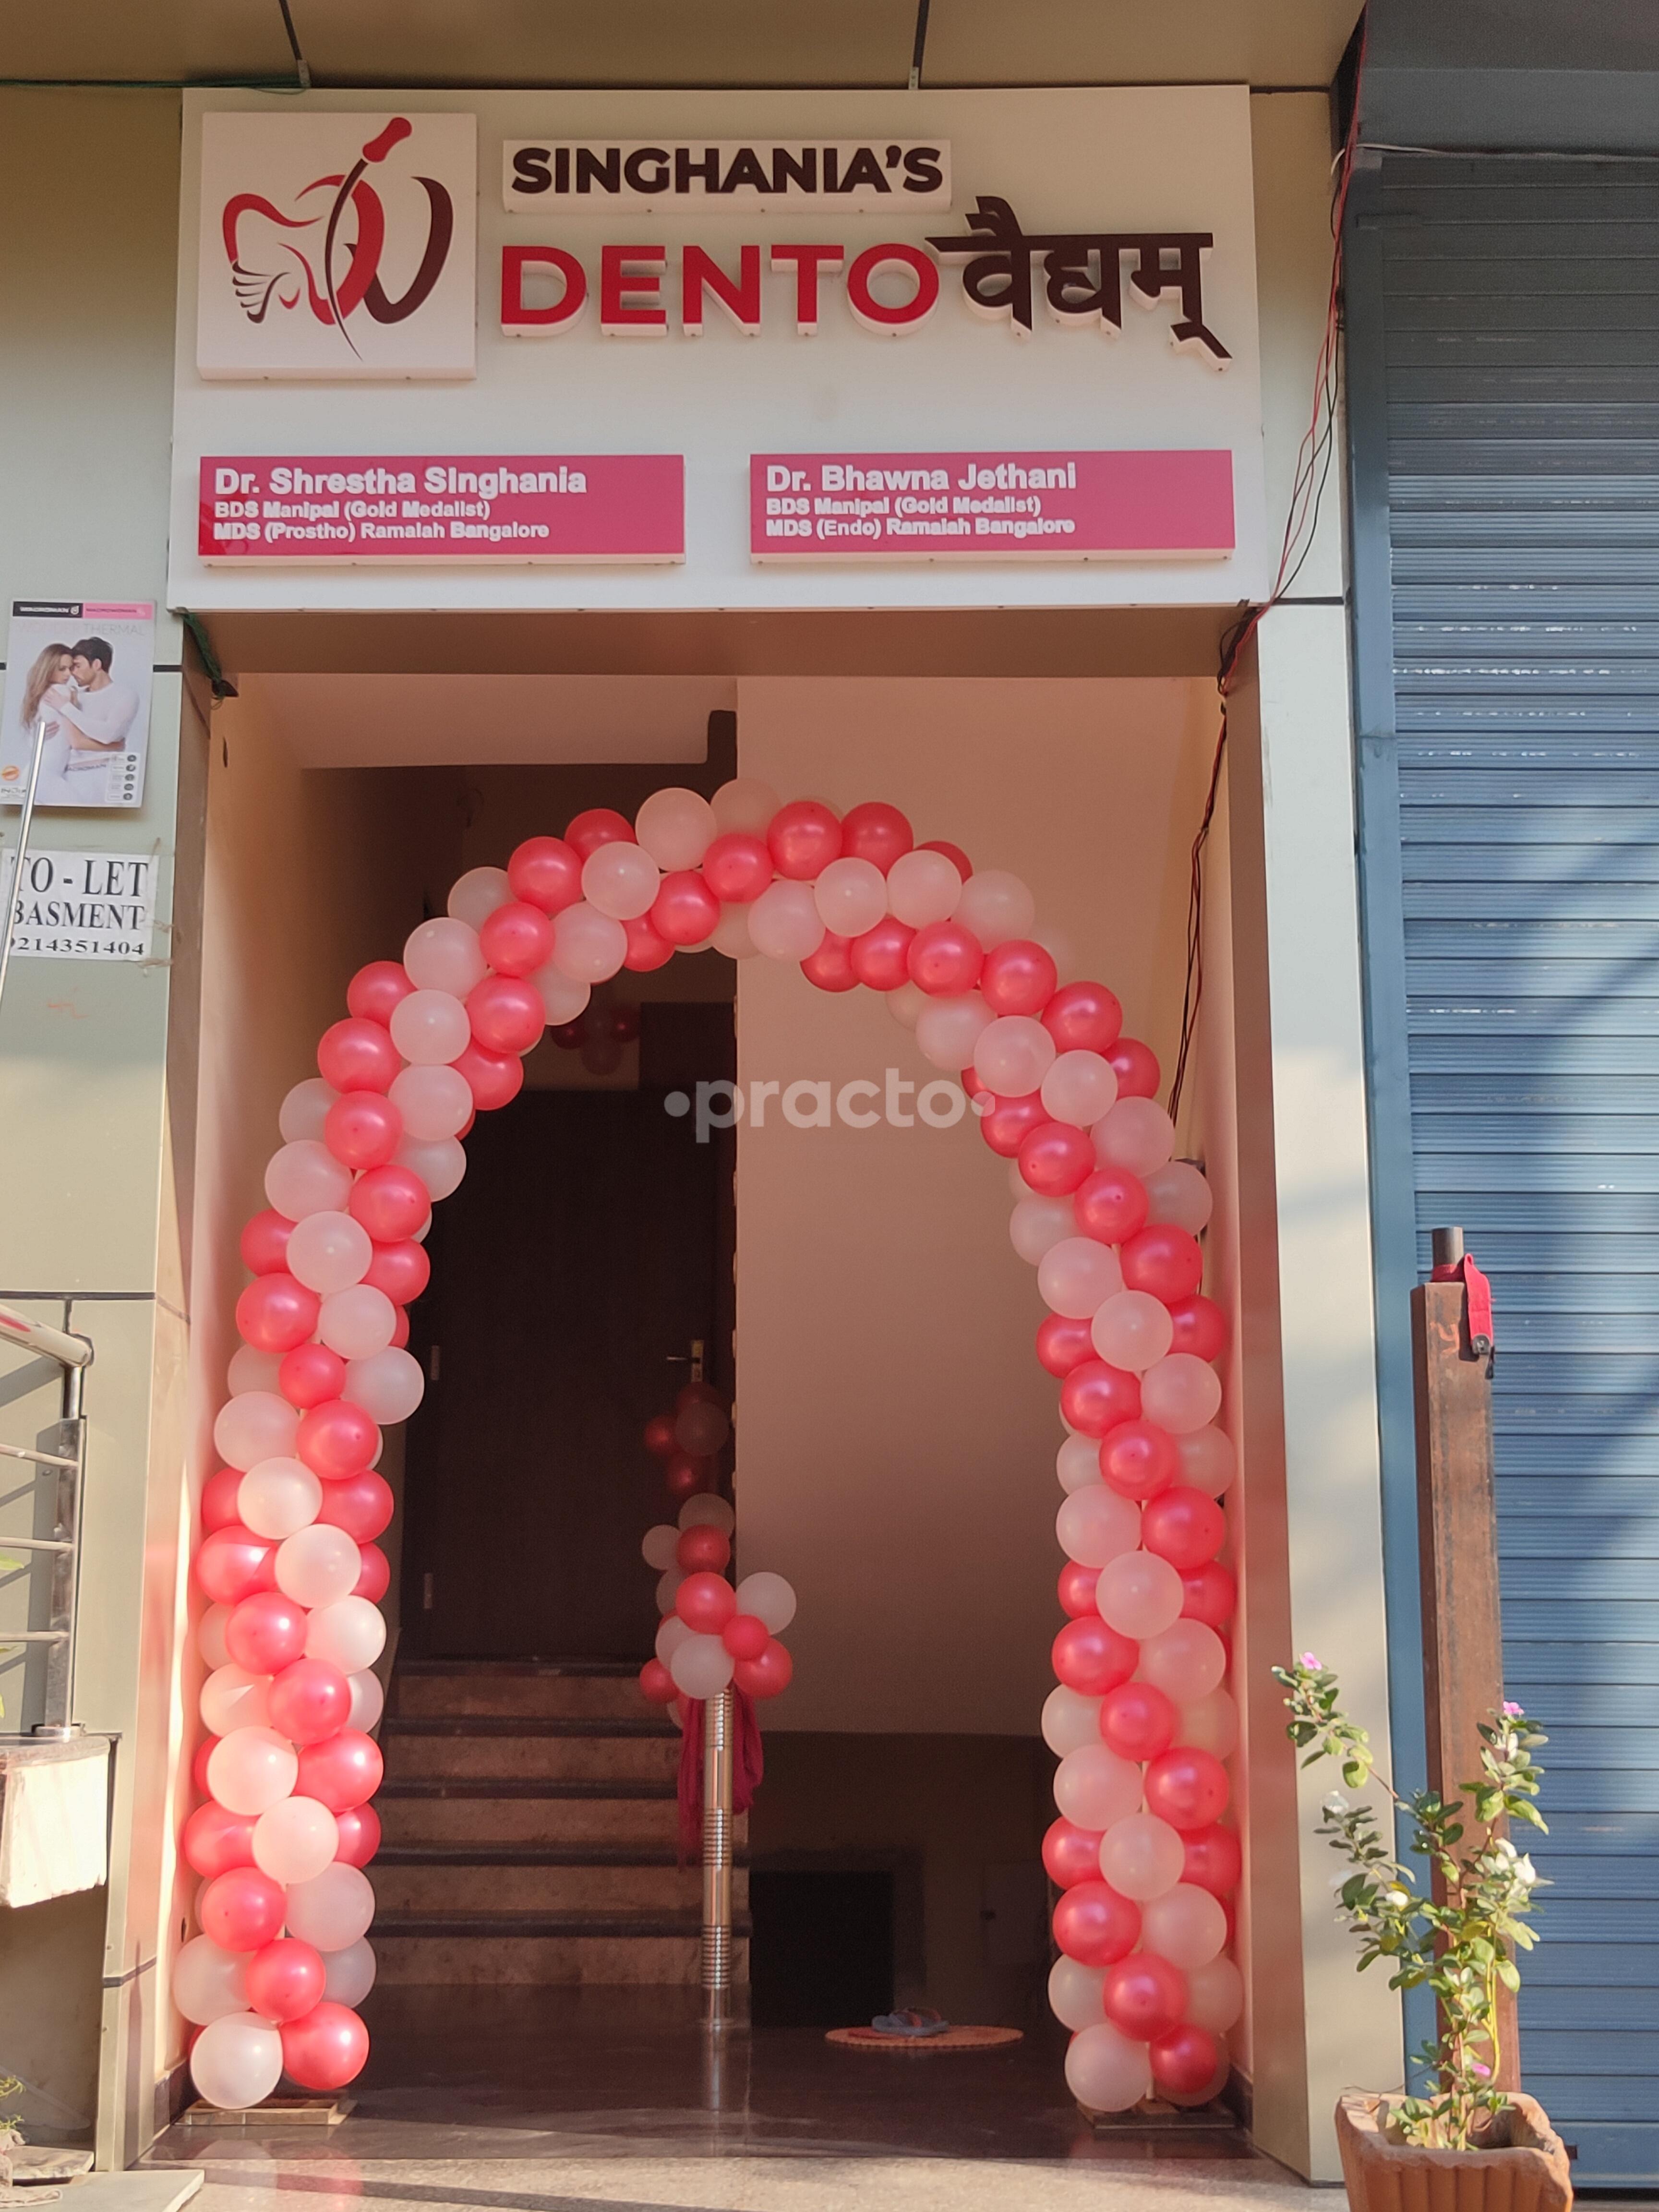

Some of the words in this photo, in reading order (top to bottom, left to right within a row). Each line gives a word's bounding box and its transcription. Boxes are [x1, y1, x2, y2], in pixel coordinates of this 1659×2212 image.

[511, 145, 943, 193] SINGHANIA'S
[501, 243, 939, 326] DENTO
[216, 468, 260, 494] Dr.
[269, 467, 416, 494] Shrestha
[424, 466, 587, 500] Singhania
[767, 465, 811, 492] Dr.
[822, 464, 950, 492] Bhawna
[958, 462, 1076, 490] Jethani
[215, 501, 259, 518] BDS
[263, 500, 339, 521] Manipal
[344, 500, 397, 521] (Gold
[402, 500, 490, 520] Medalist)
[767, 497, 810, 515] BDS
[815, 496, 889, 517] Manipal
[894, 496, 948, 517] (Gold
[953, 495, 1041, 517] Medalist)
[214, 522, 261, 540] MDS
[265, 521, 356, 543] (Prostho)
[361, 522, 445, 539] Ramaiah
[450, 521, 550, 541] Bangalore
[766, 518, 812, 537] MDS
[817, 518, 881, 540] (Endo)
[887, 517, 971, 536] Ramaiah
[975, 517, 1075, 538] Bangalore
[82, 860, 149, 897] LET
